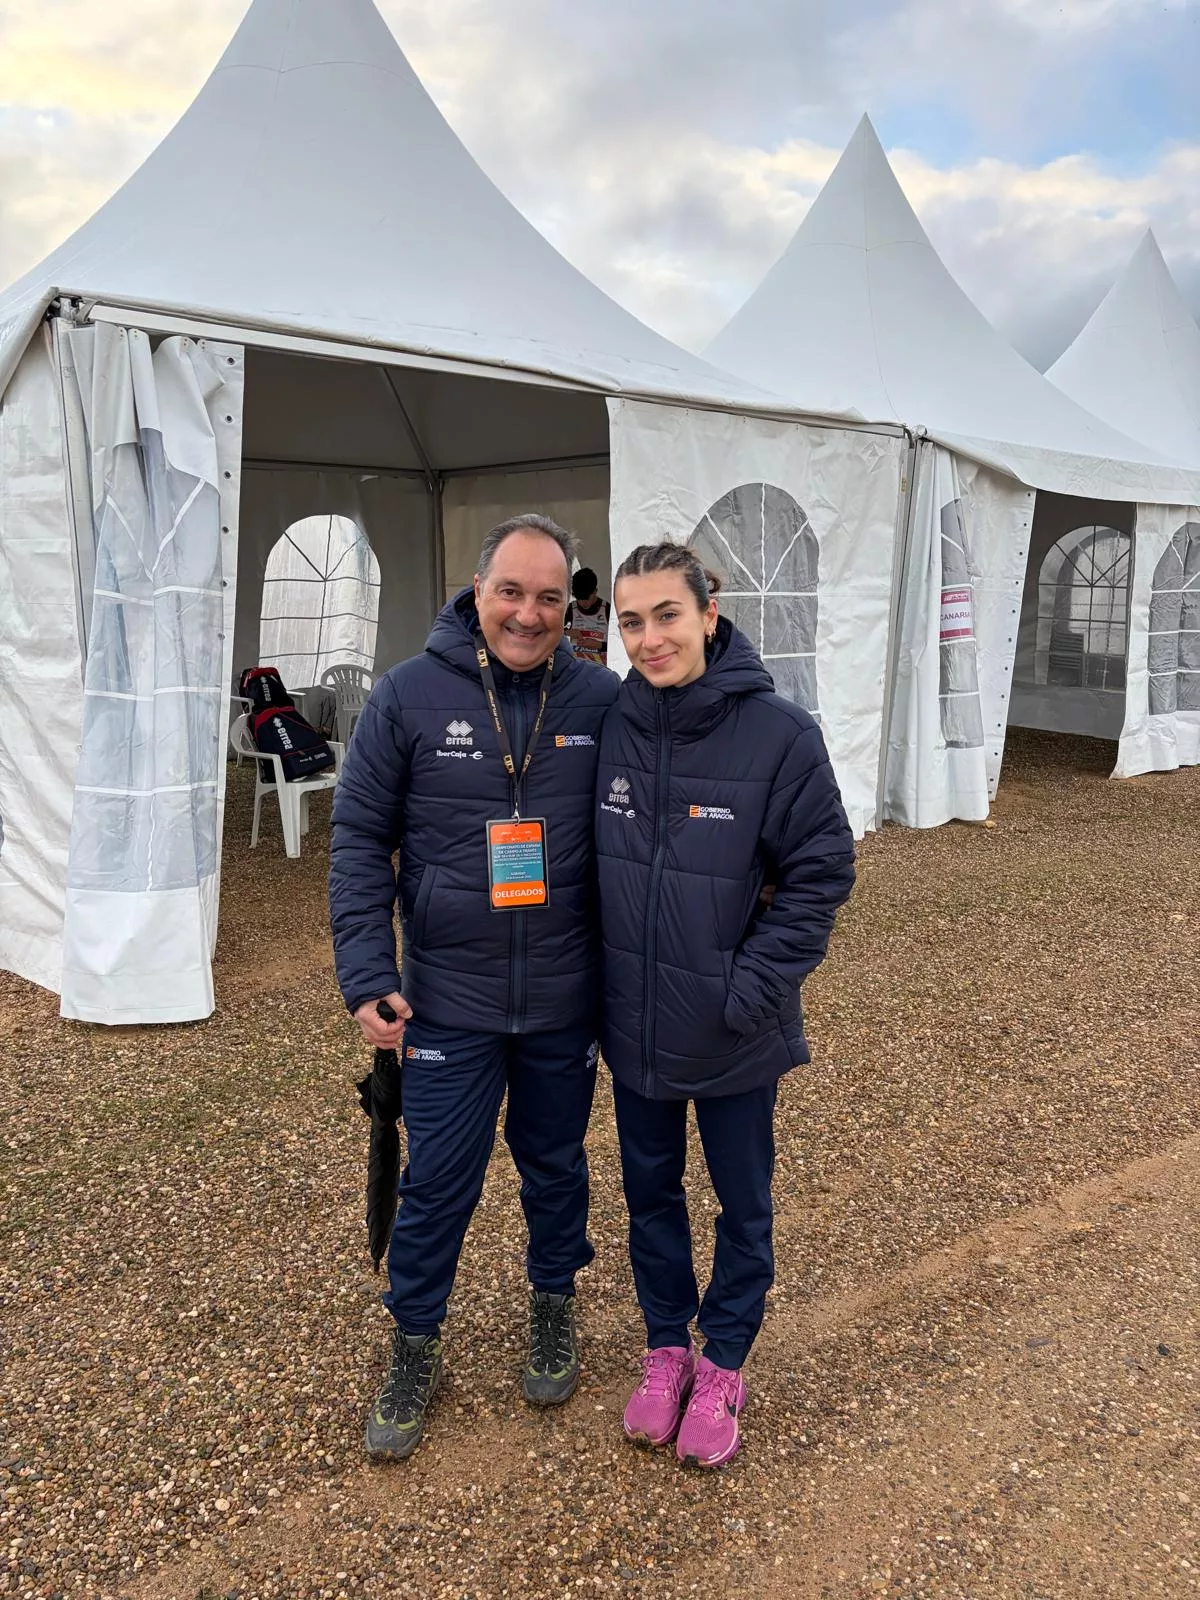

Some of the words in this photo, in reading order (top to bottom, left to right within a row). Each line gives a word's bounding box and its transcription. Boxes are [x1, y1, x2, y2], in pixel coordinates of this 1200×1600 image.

[277, 727, 294, 750] errea
[446, 736, 473, 745] errea
[609, 793, 630, 804] errea
[495, 888, 544, 899] DELEGADOS
